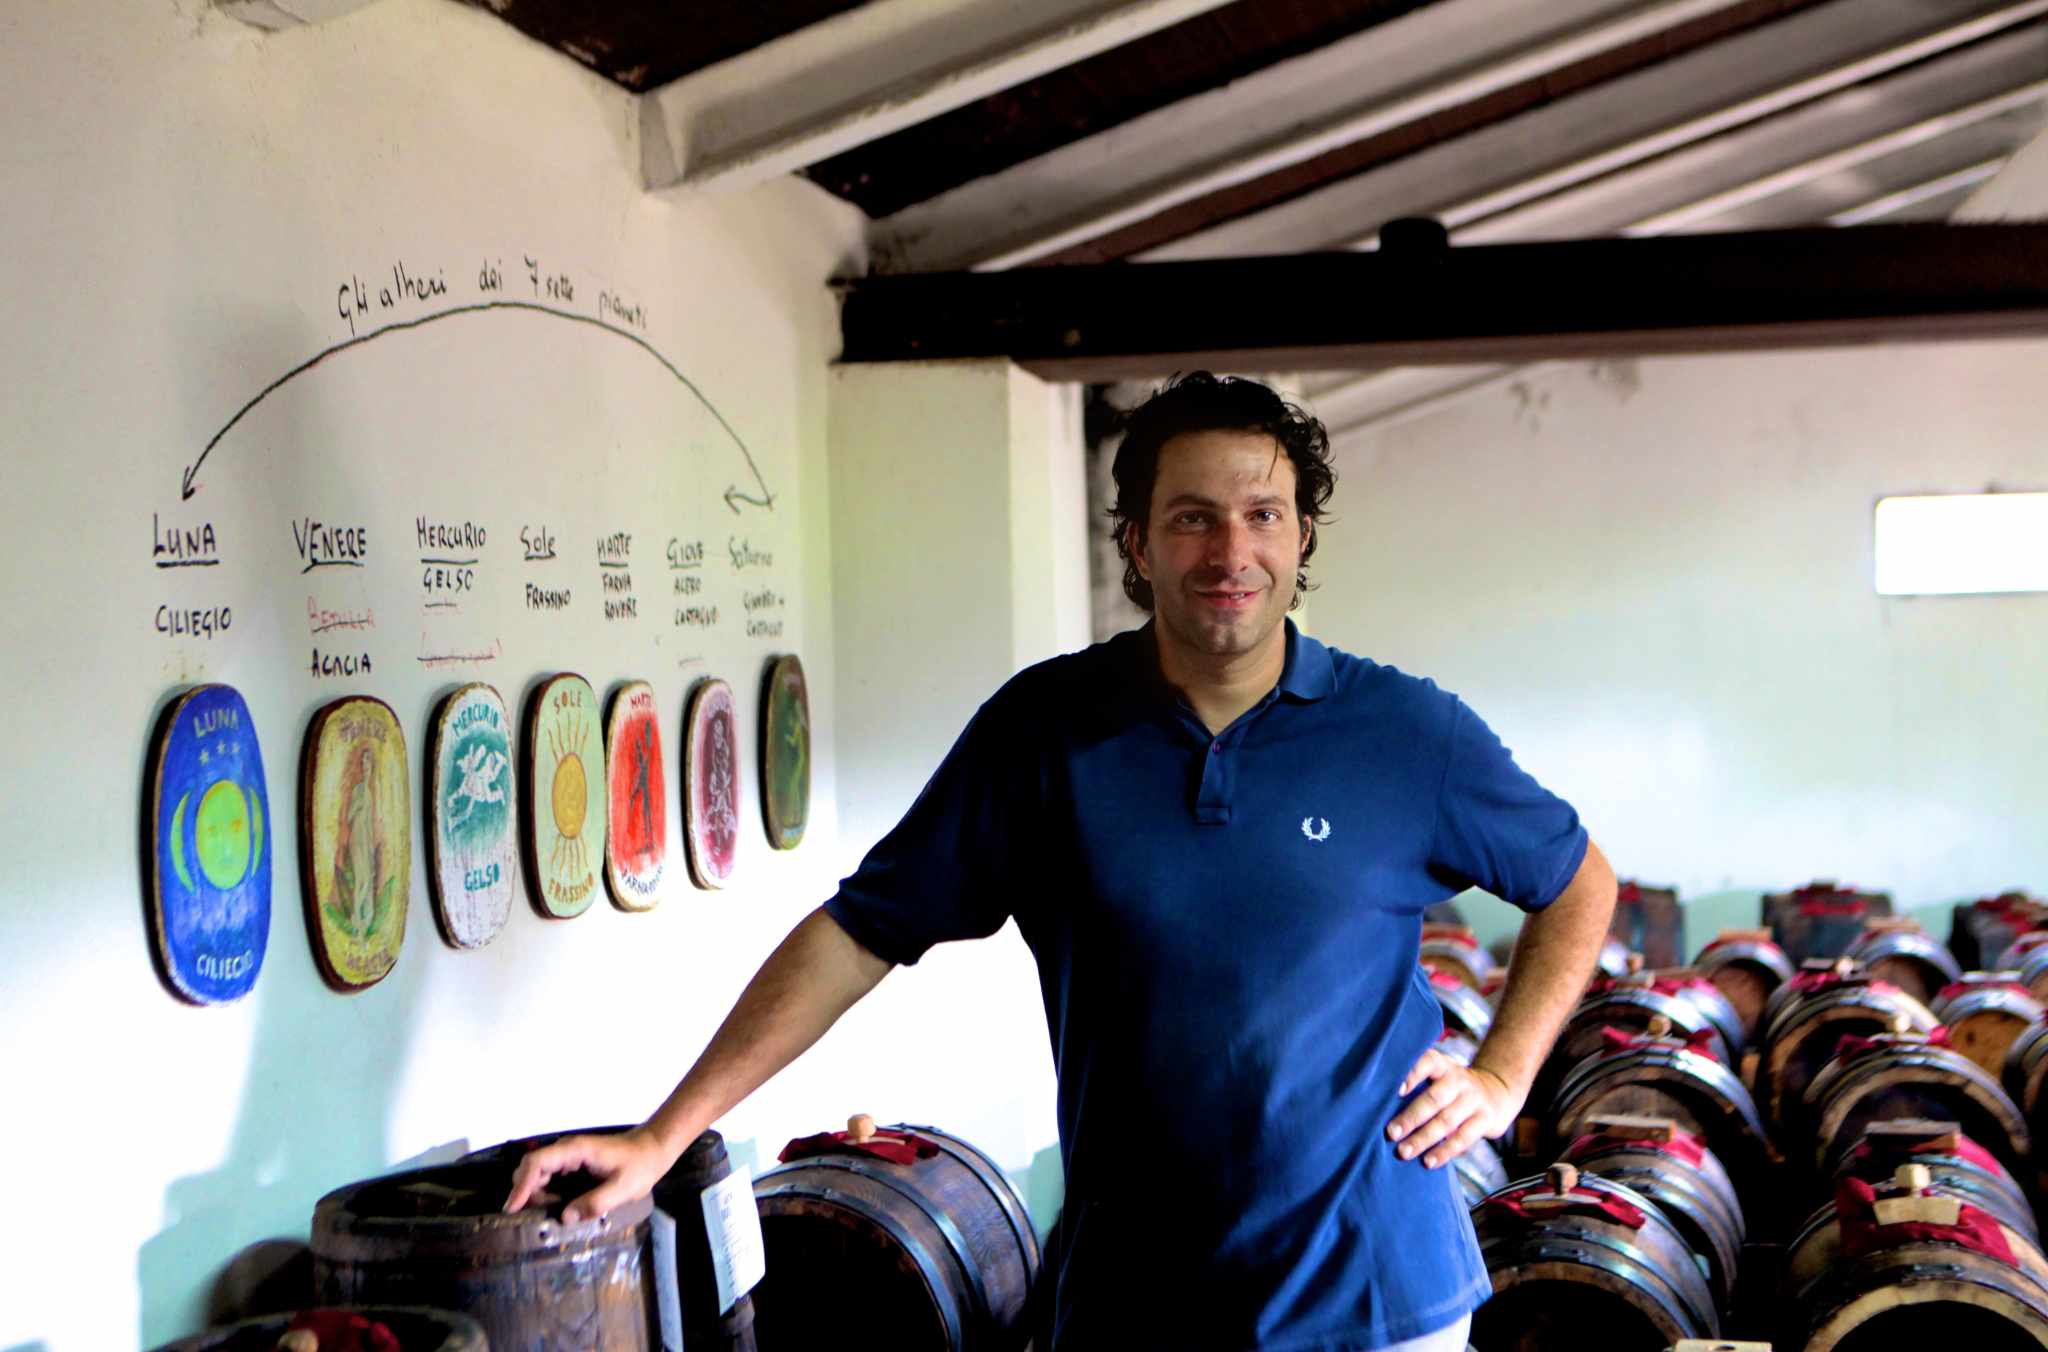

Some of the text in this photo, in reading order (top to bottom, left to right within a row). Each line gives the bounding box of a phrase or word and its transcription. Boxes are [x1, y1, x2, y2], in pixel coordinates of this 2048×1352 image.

[338, 273, 369, 337] Gli
[479, 256, 502, 292] dei
[523, 252, 538, 298] 7
[153, 513, 217, 557] LUNA
[293, 517, 367, 562] VENERE
[416, 516, 486, 550] MERCURIO
[597, 533, 632, 559] MARTE
[423, 569, 474, 593] GELSO
[526, 583, 571, 611] FRASSINO
[155, 605, 232, 639] CILIEGIO
[312, 648, 372, 679] ACACIA
[553, 691, 583, 715] SOLE
[192, 708, 240, 739] LUNA
[452, 702, 499, 737] MERCURIO
[464, 862, 500, 893] GELSO
